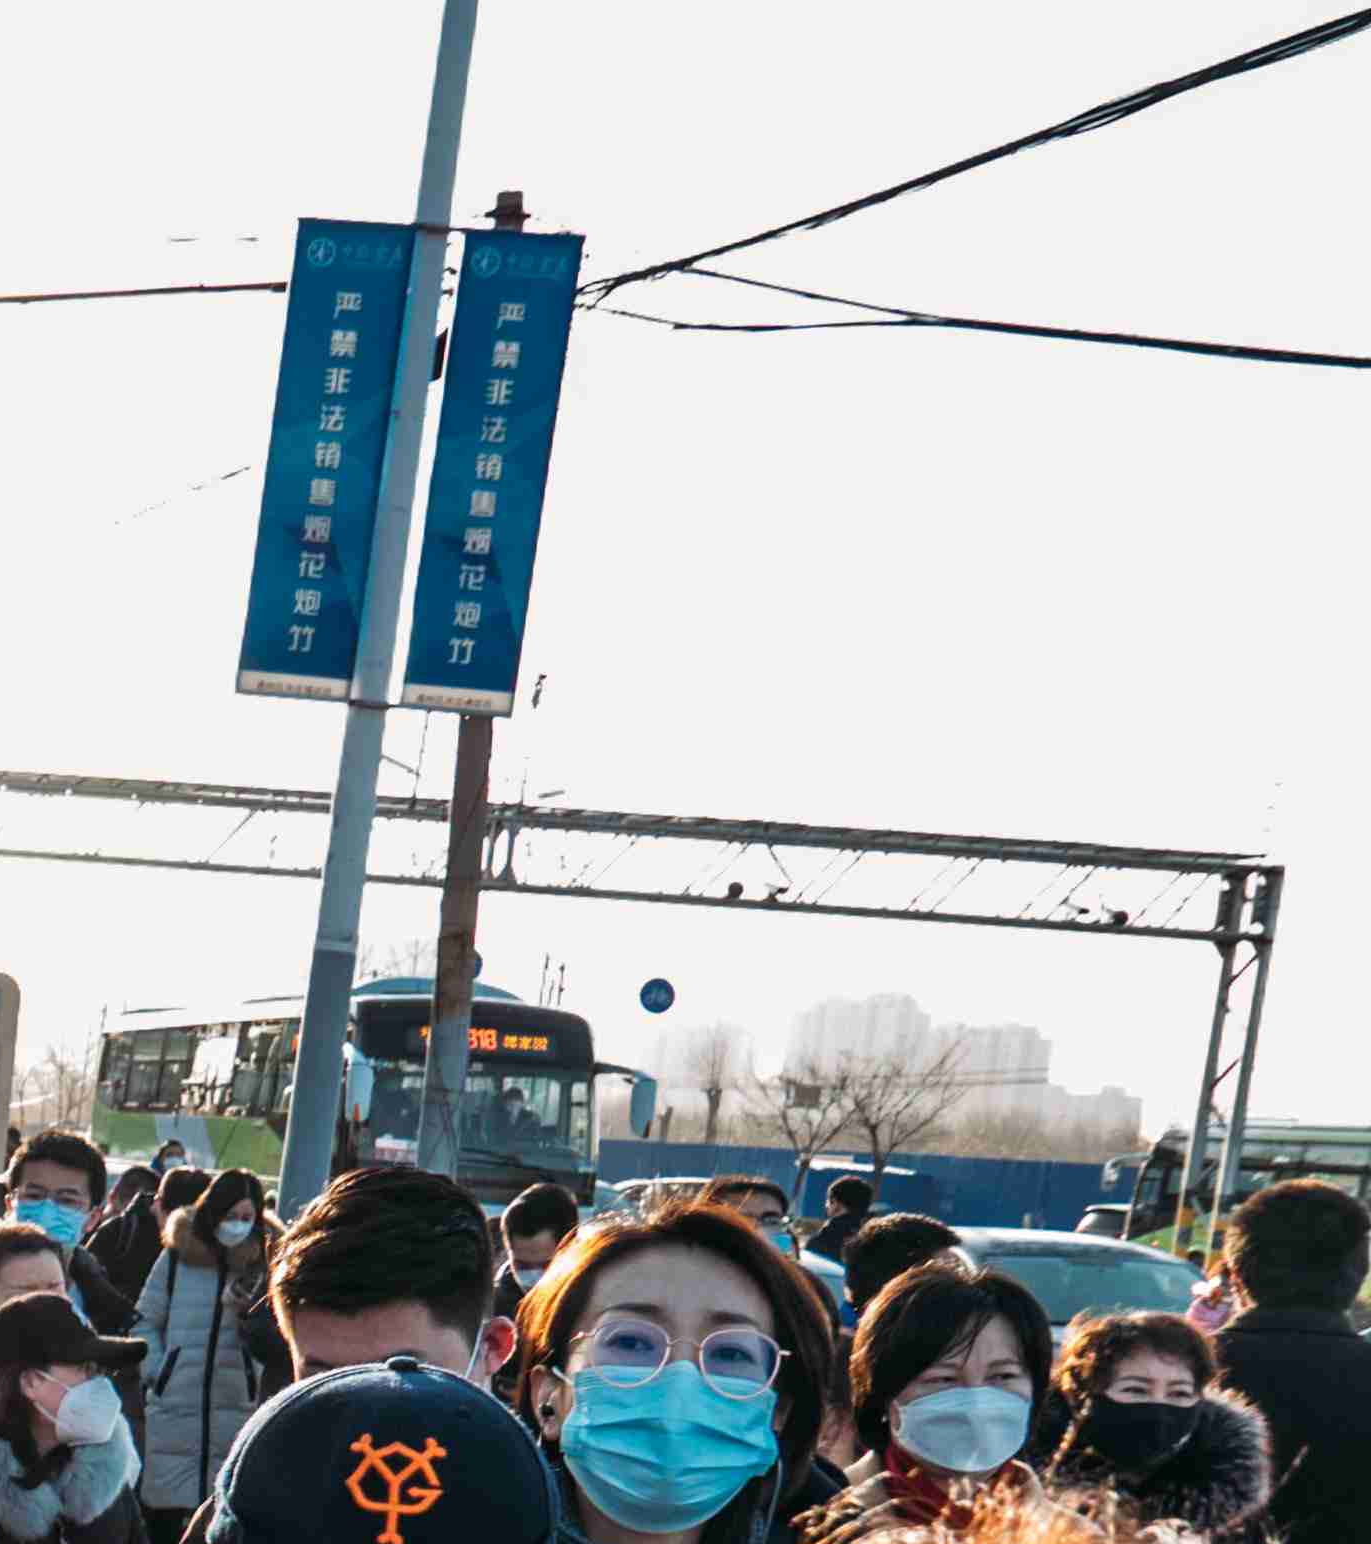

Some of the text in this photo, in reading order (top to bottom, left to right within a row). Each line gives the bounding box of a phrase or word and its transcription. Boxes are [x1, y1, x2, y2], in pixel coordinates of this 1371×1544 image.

[288, 291, 363, 652] 严禁非法销售烟花炮竹
[447, 303, 526, 665] 严禁非法销售烟花炮竹
